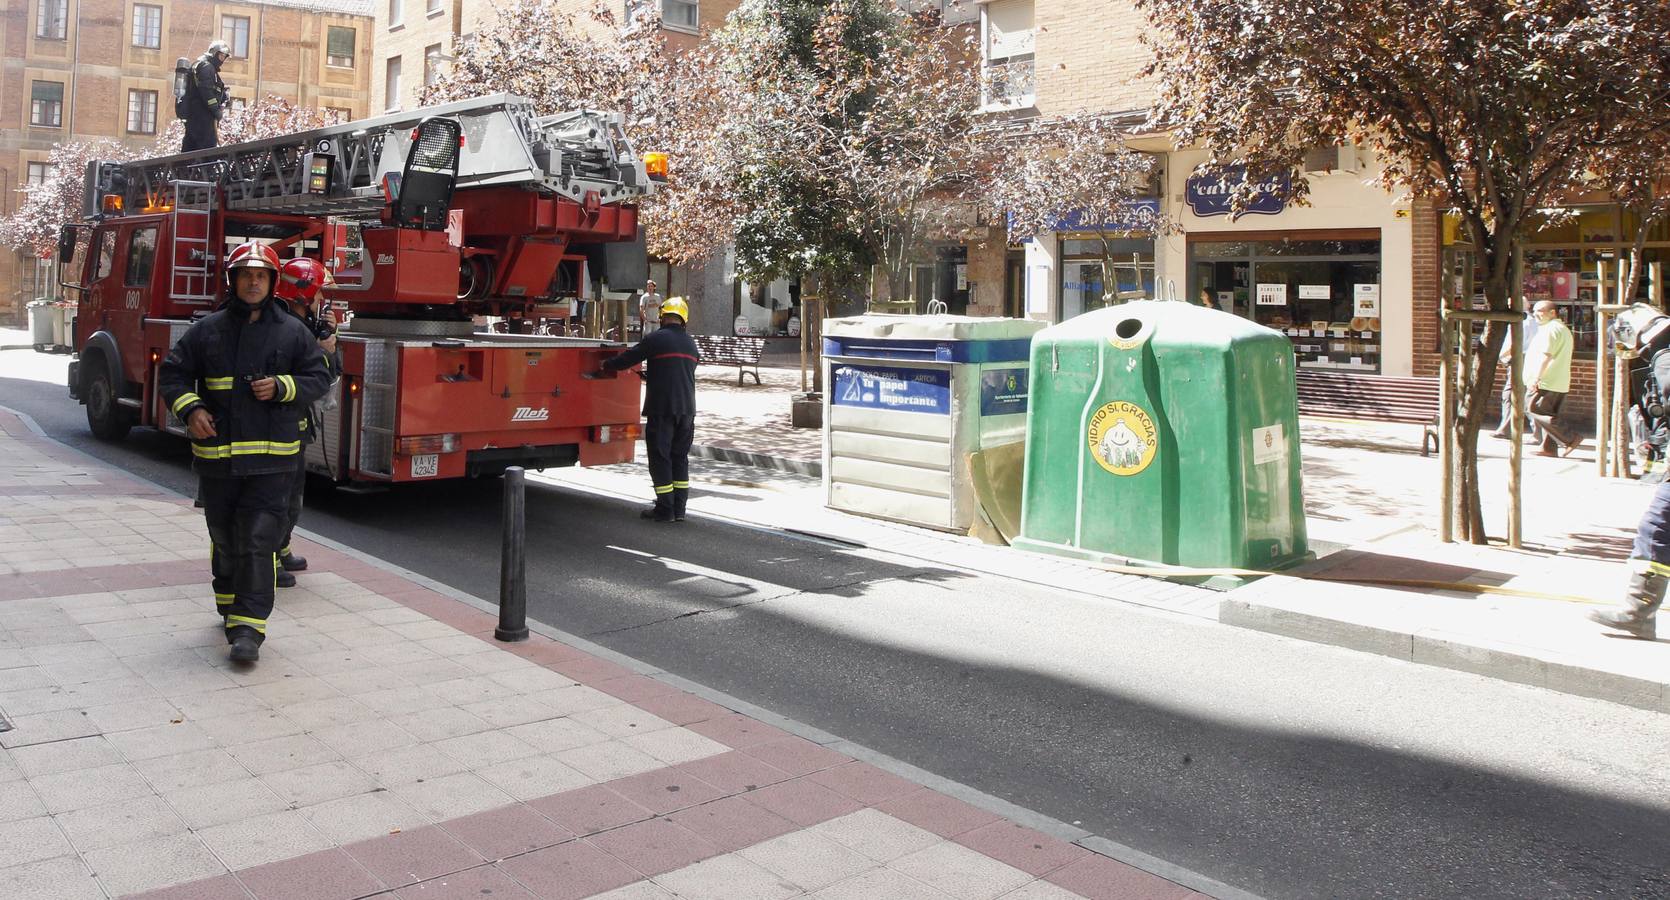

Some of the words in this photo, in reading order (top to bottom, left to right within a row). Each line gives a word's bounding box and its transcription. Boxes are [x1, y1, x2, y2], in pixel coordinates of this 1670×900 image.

[1194, 178, 1275, 195] carrsco
[376, 253, 395, 264] Metz
[125, 290, 140, 309] 080
[512, 407, 549, 421] Metz
[1090, 409, 1107, 446] VIDRIO
[1121, 403, 1156, 447] GRACIAS
